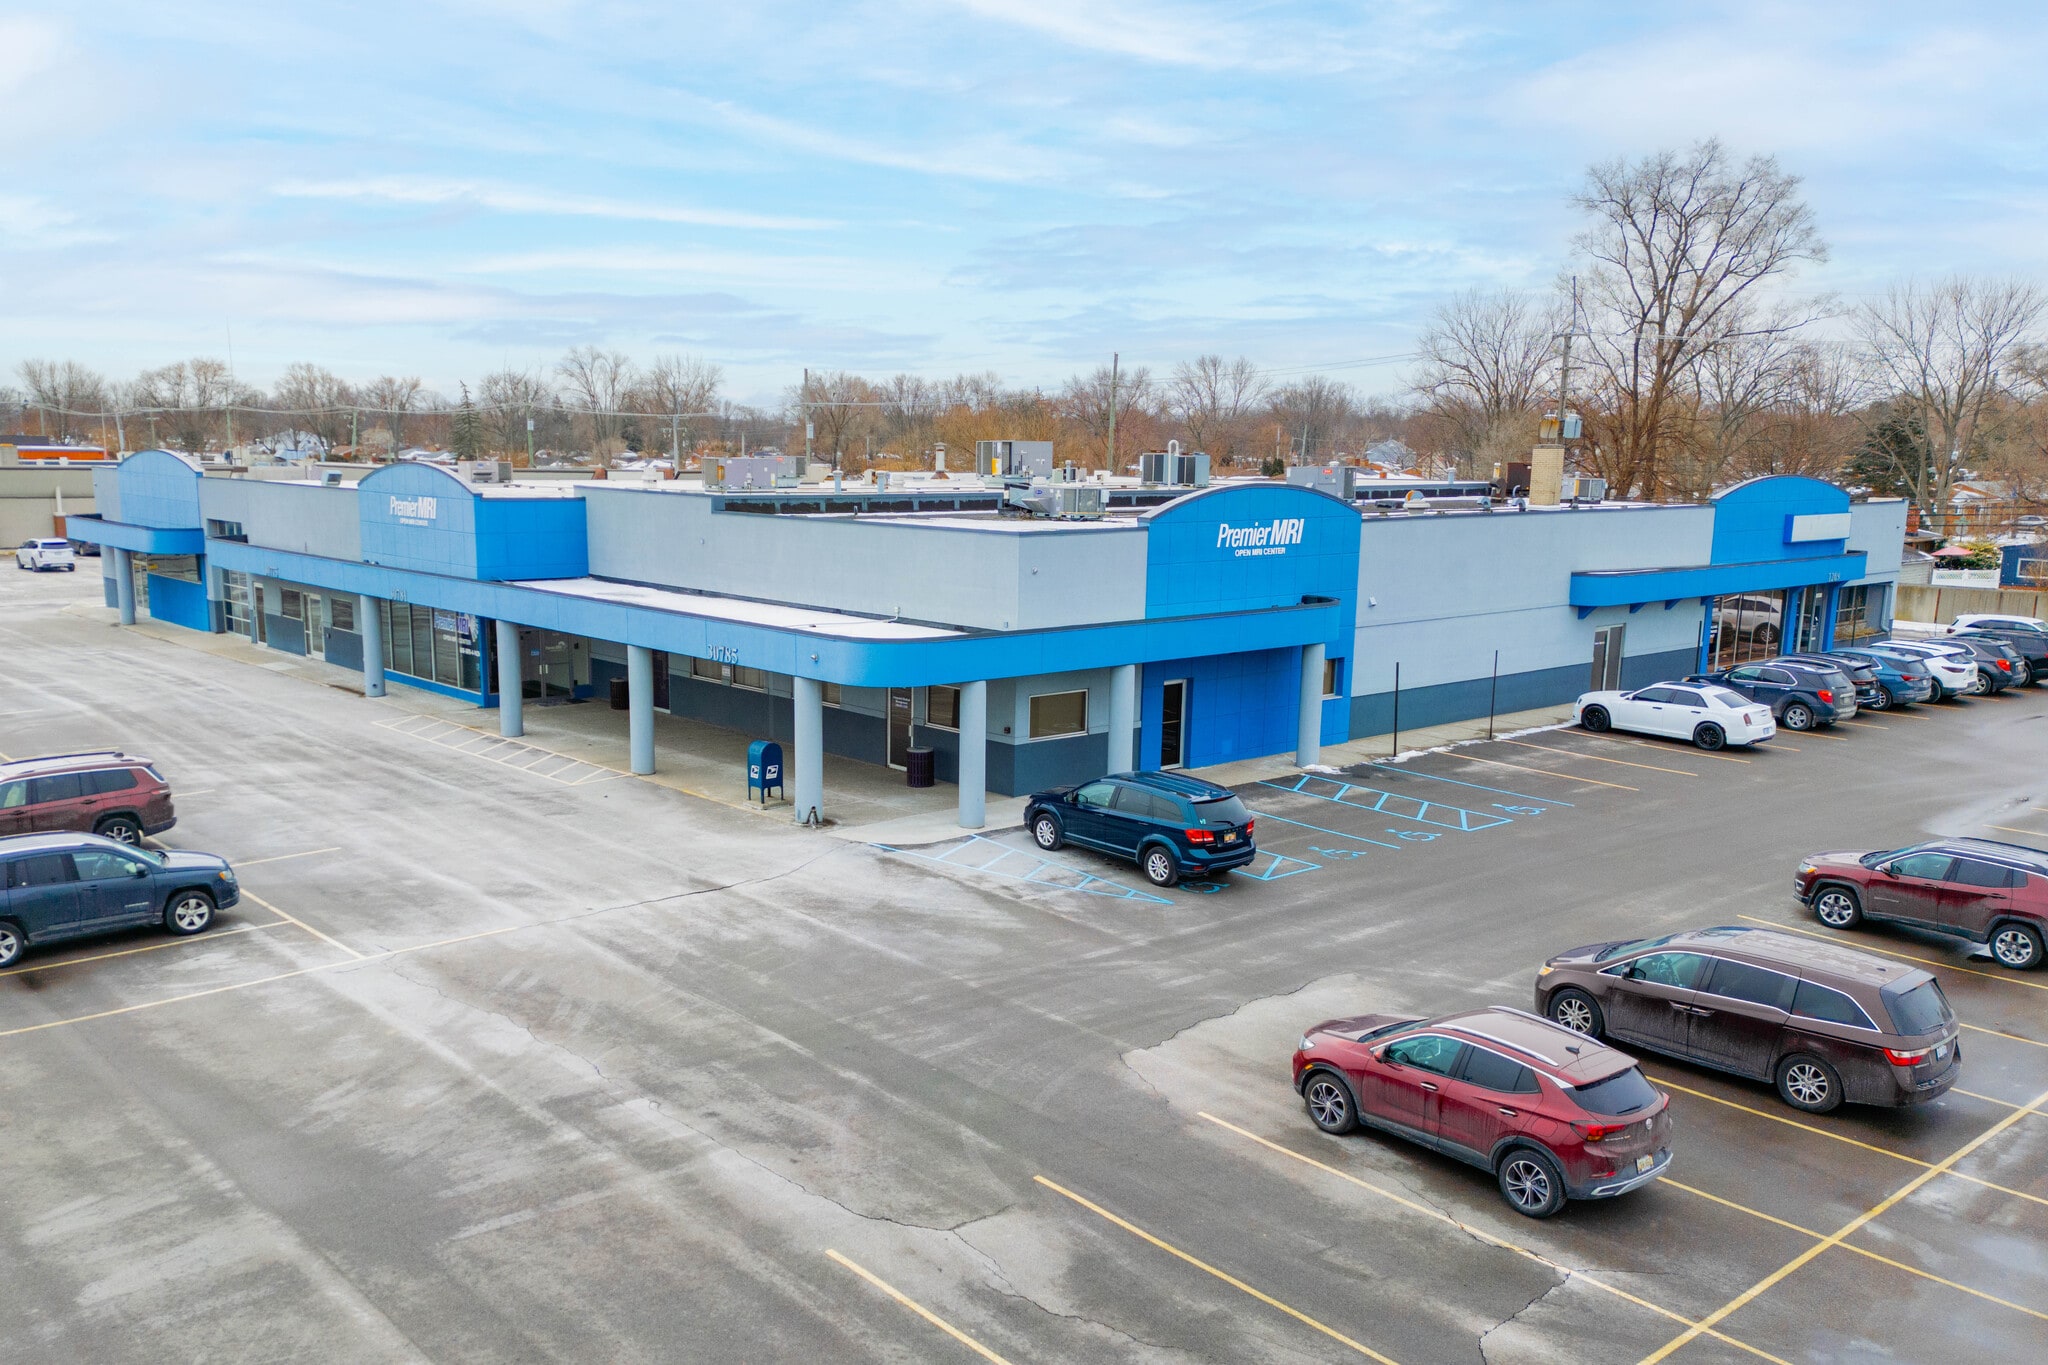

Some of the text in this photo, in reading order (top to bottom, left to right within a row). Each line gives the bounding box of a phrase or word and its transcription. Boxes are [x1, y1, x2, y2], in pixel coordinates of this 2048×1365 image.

[1216, 518, 1305, 548] PremierMRI
[1235, 549, 1250, 557] OPEN
[1264, 547, 1285, 556] CENTER
[707, 644, 738, 664] 30785
